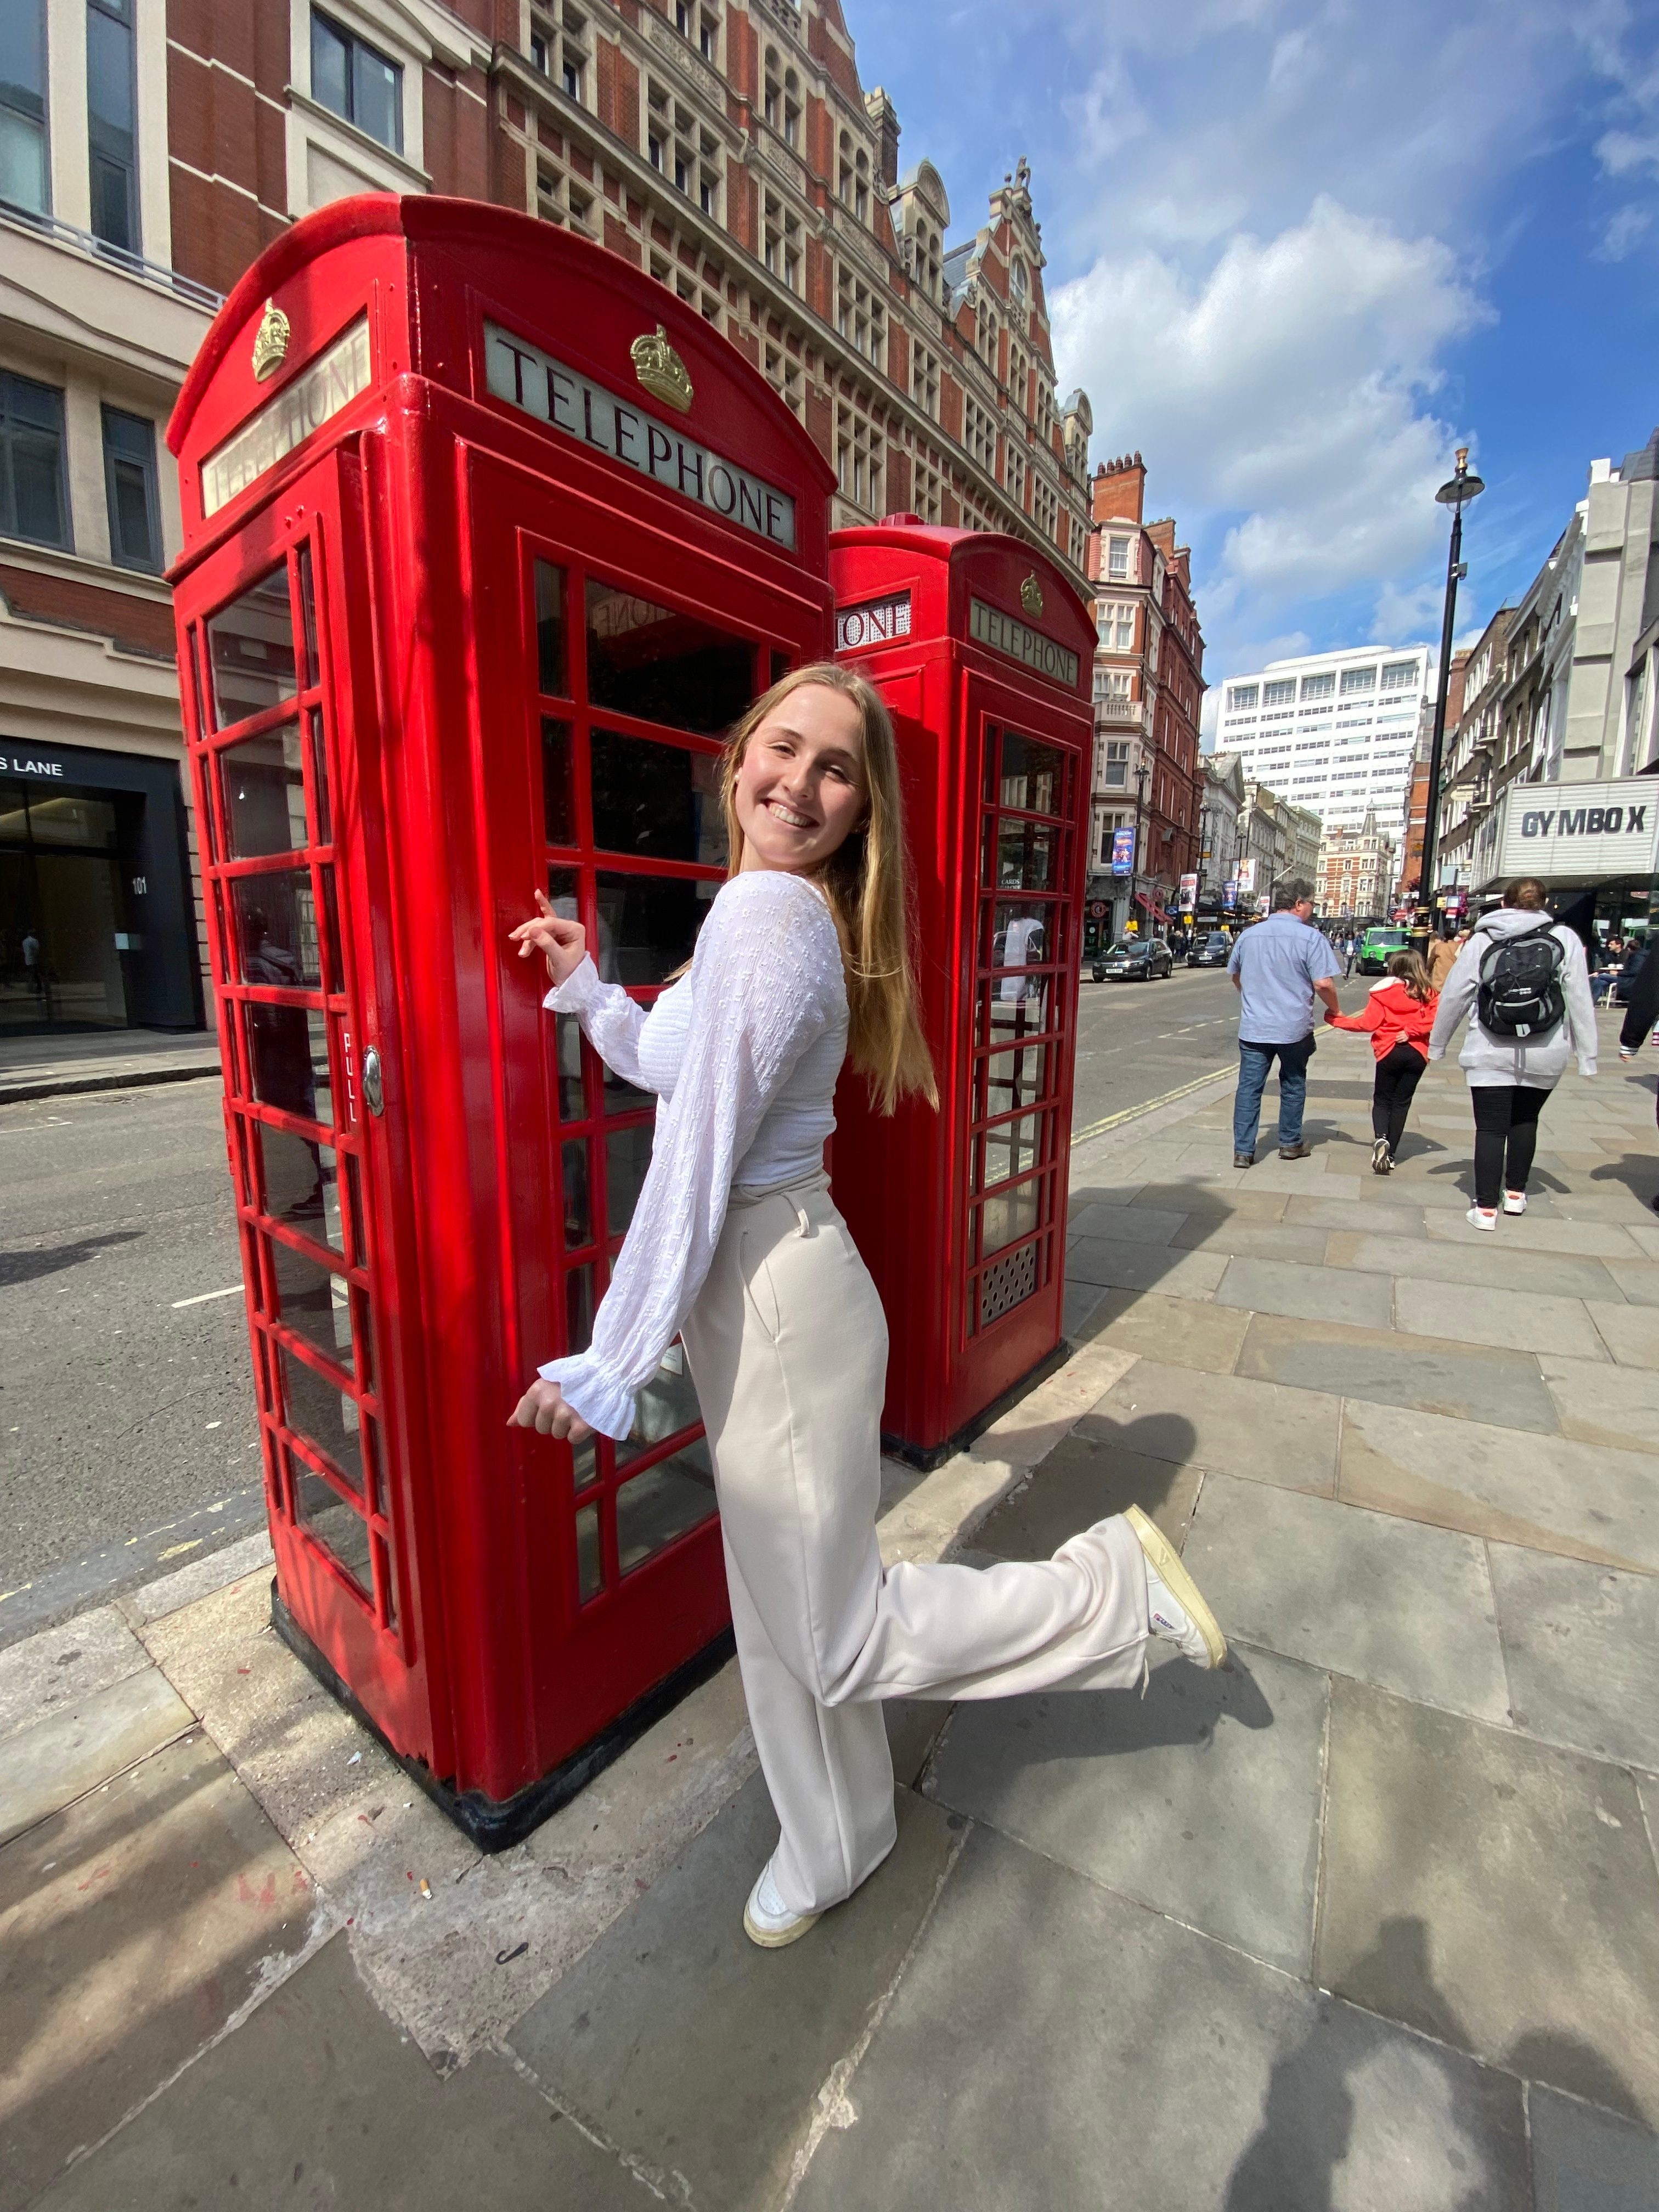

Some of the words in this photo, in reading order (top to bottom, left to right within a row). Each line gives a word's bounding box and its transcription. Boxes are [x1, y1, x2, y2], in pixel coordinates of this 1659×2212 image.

[496, 338, 784, 544] TELEPHONE
[835, 603, 908, 648] ONE
[974, 603, 1075, 685] TELEPHONE
[13, 759, 63, 776] LANE
[1521, 805, 1646, 838] GYMBOX
[133, 876, 147, 895] 101
[343, 1032, 357, 1122] PULL
